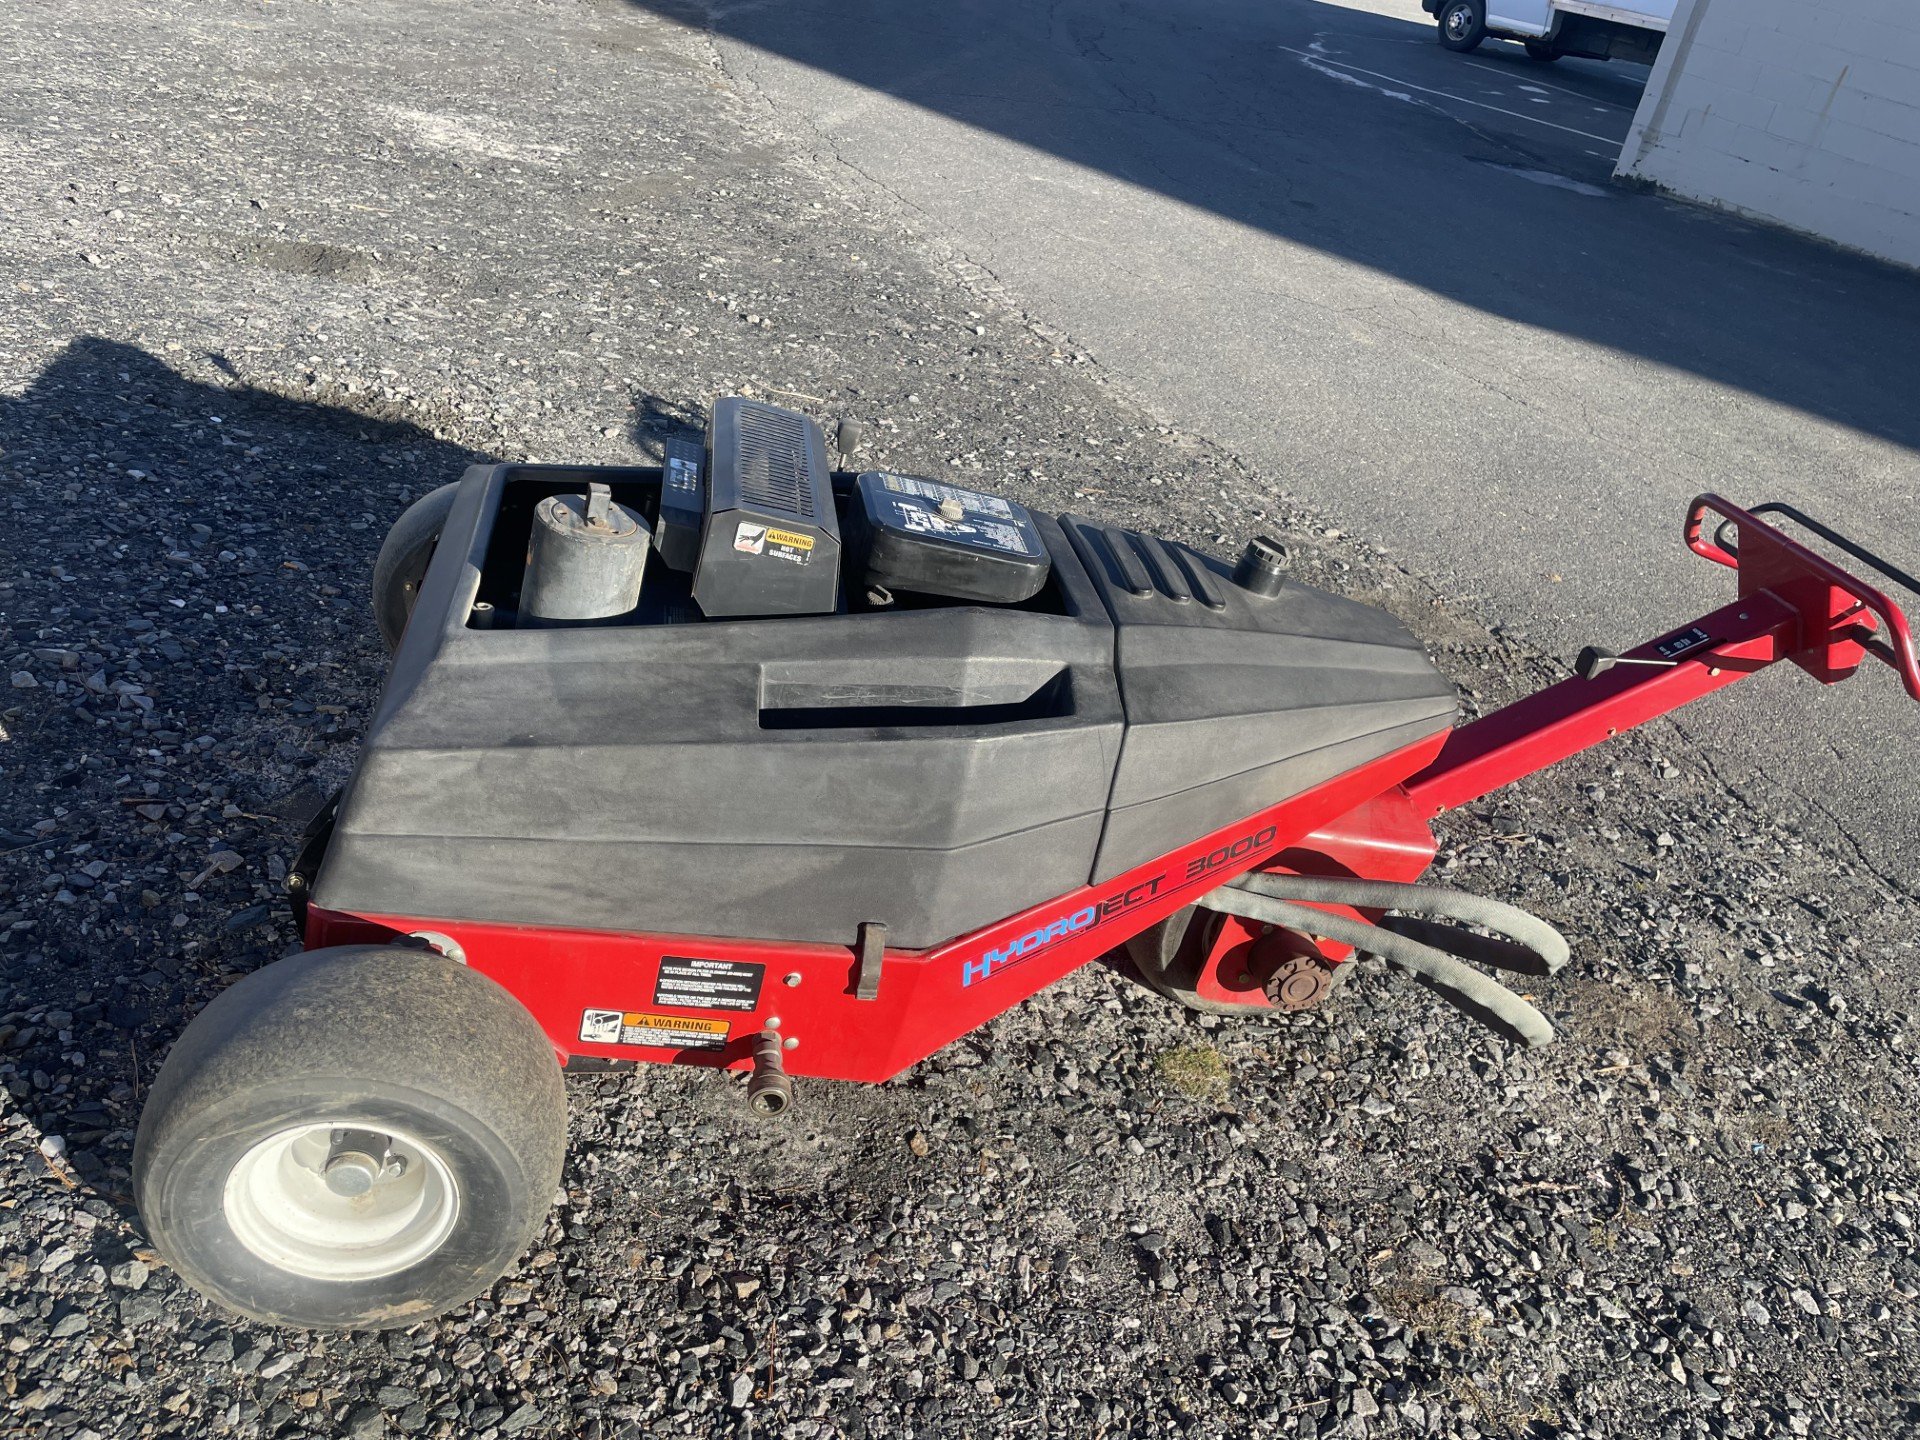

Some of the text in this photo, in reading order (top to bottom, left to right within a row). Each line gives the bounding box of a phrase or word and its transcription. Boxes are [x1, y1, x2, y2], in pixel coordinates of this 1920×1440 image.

[775, 533, 813, 548] WARNING
[769, 549, 802, 563] SURFACES
[780, 545, 795, 554] HOT
[962, 825, 1278, 989] HYDROJECT 3000
[690, 960, 734, 970] IMPORTANT
[653, 1018, 712, 1031] WARNING
